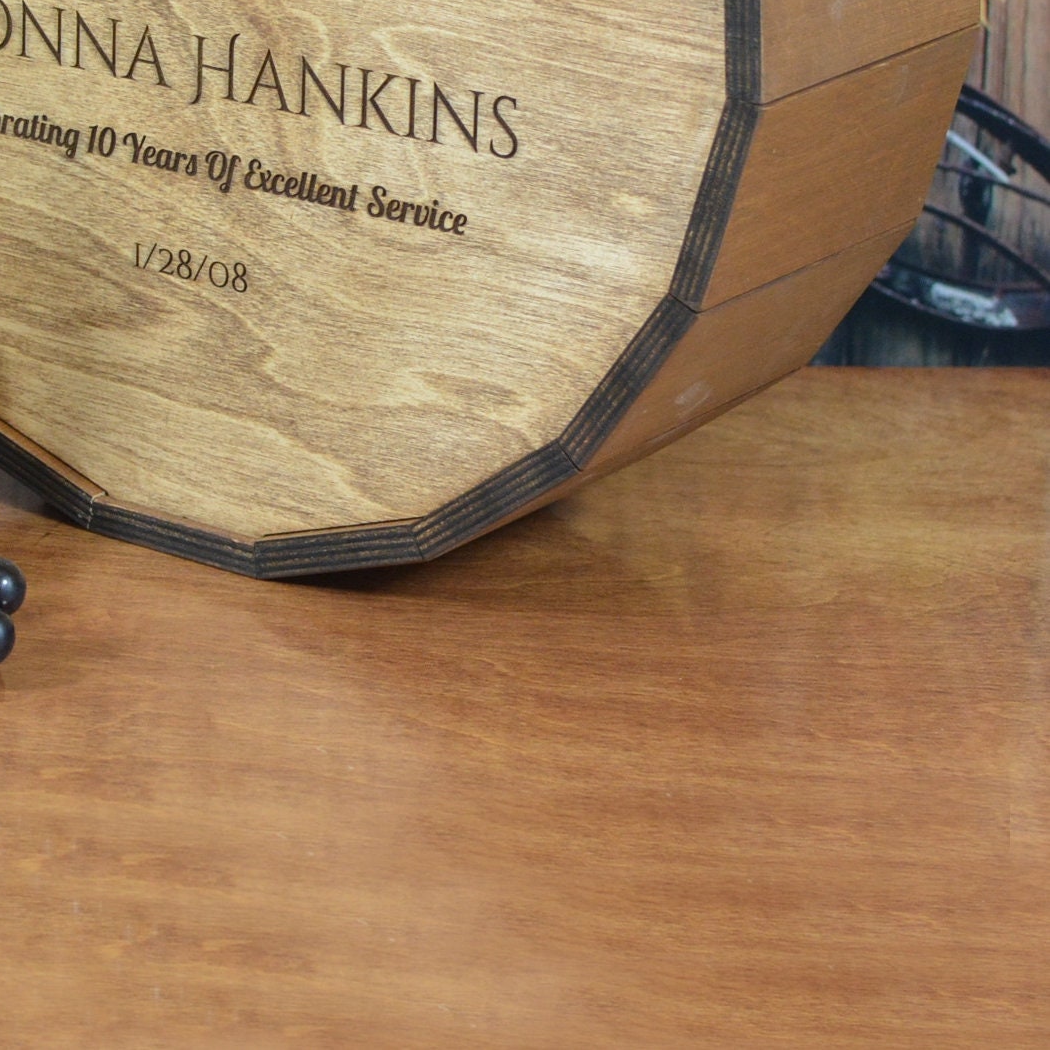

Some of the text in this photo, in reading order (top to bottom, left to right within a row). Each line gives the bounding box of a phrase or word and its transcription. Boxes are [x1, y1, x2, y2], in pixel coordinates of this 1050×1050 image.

[189, 33, 519, 160] HANKINS
[86, 124, 118, 158] 10
[122, 132, 199, 178] Years
[205, 150, 243, 194] Of
[244, 158, 359, 212] Excellent
[366, 184, 469, 236] Service
[133, 241, 250, 295] 1/28/08
